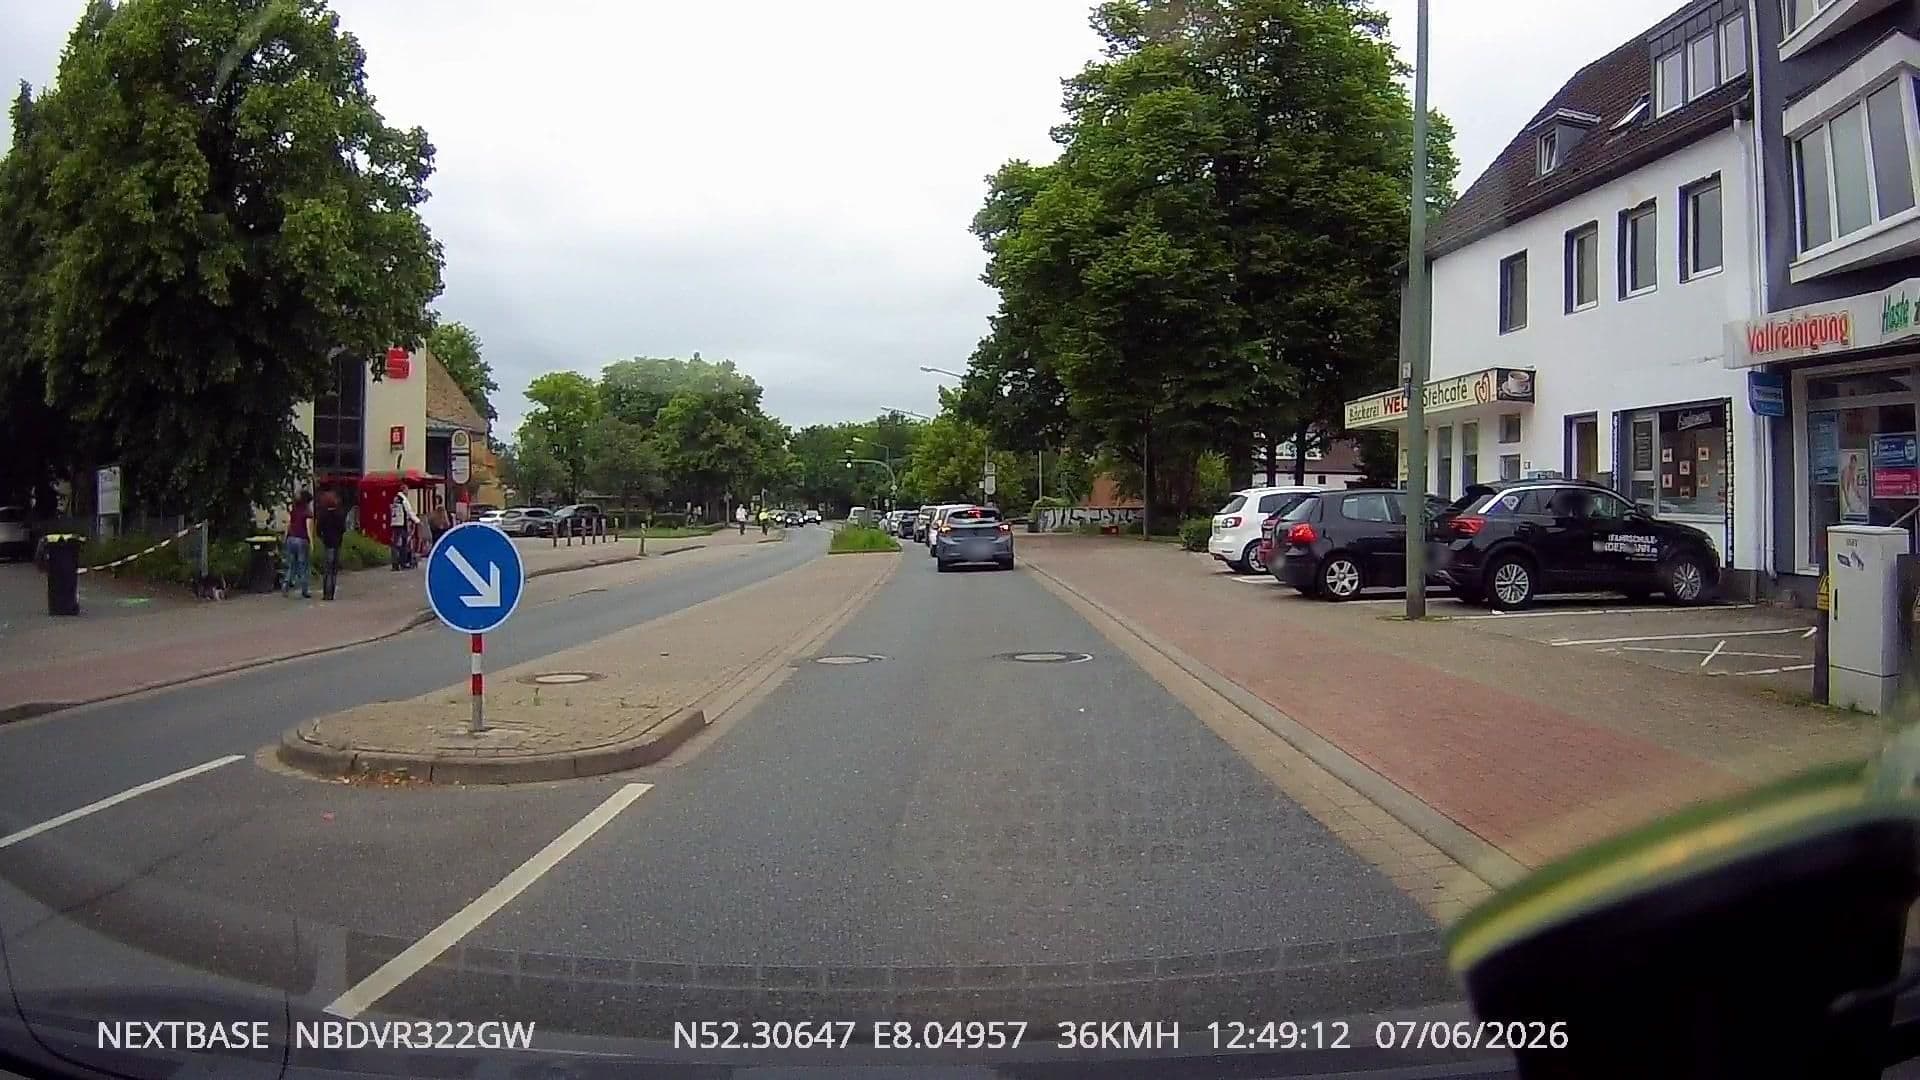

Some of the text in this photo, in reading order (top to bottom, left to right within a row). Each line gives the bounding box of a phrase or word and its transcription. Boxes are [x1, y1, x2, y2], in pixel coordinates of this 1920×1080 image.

[1747, 311, 1849, 353] Vollreinigung
[1383, 394, 1408, 415] WEL
[1422, 378, 1468, 407] Stehcafé
